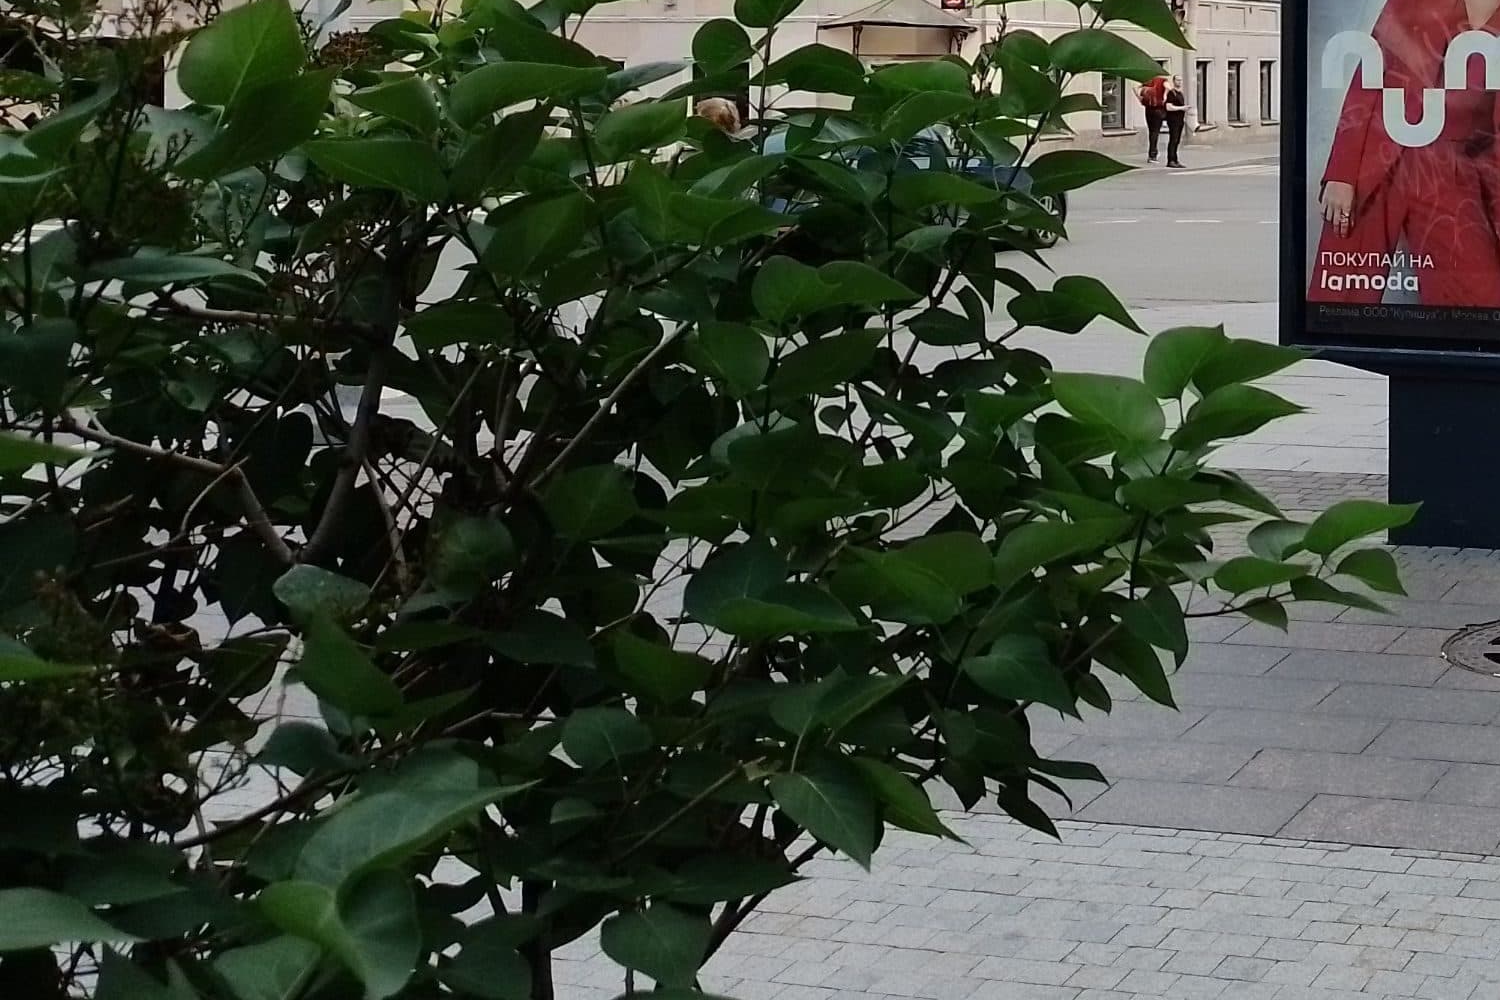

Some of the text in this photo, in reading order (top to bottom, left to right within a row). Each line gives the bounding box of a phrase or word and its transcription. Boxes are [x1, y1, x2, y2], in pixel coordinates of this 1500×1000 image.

[1321, 250, 1434, 269] ПОКУПАЙ НА
[1321, 269, 1419, 291] lamoda
